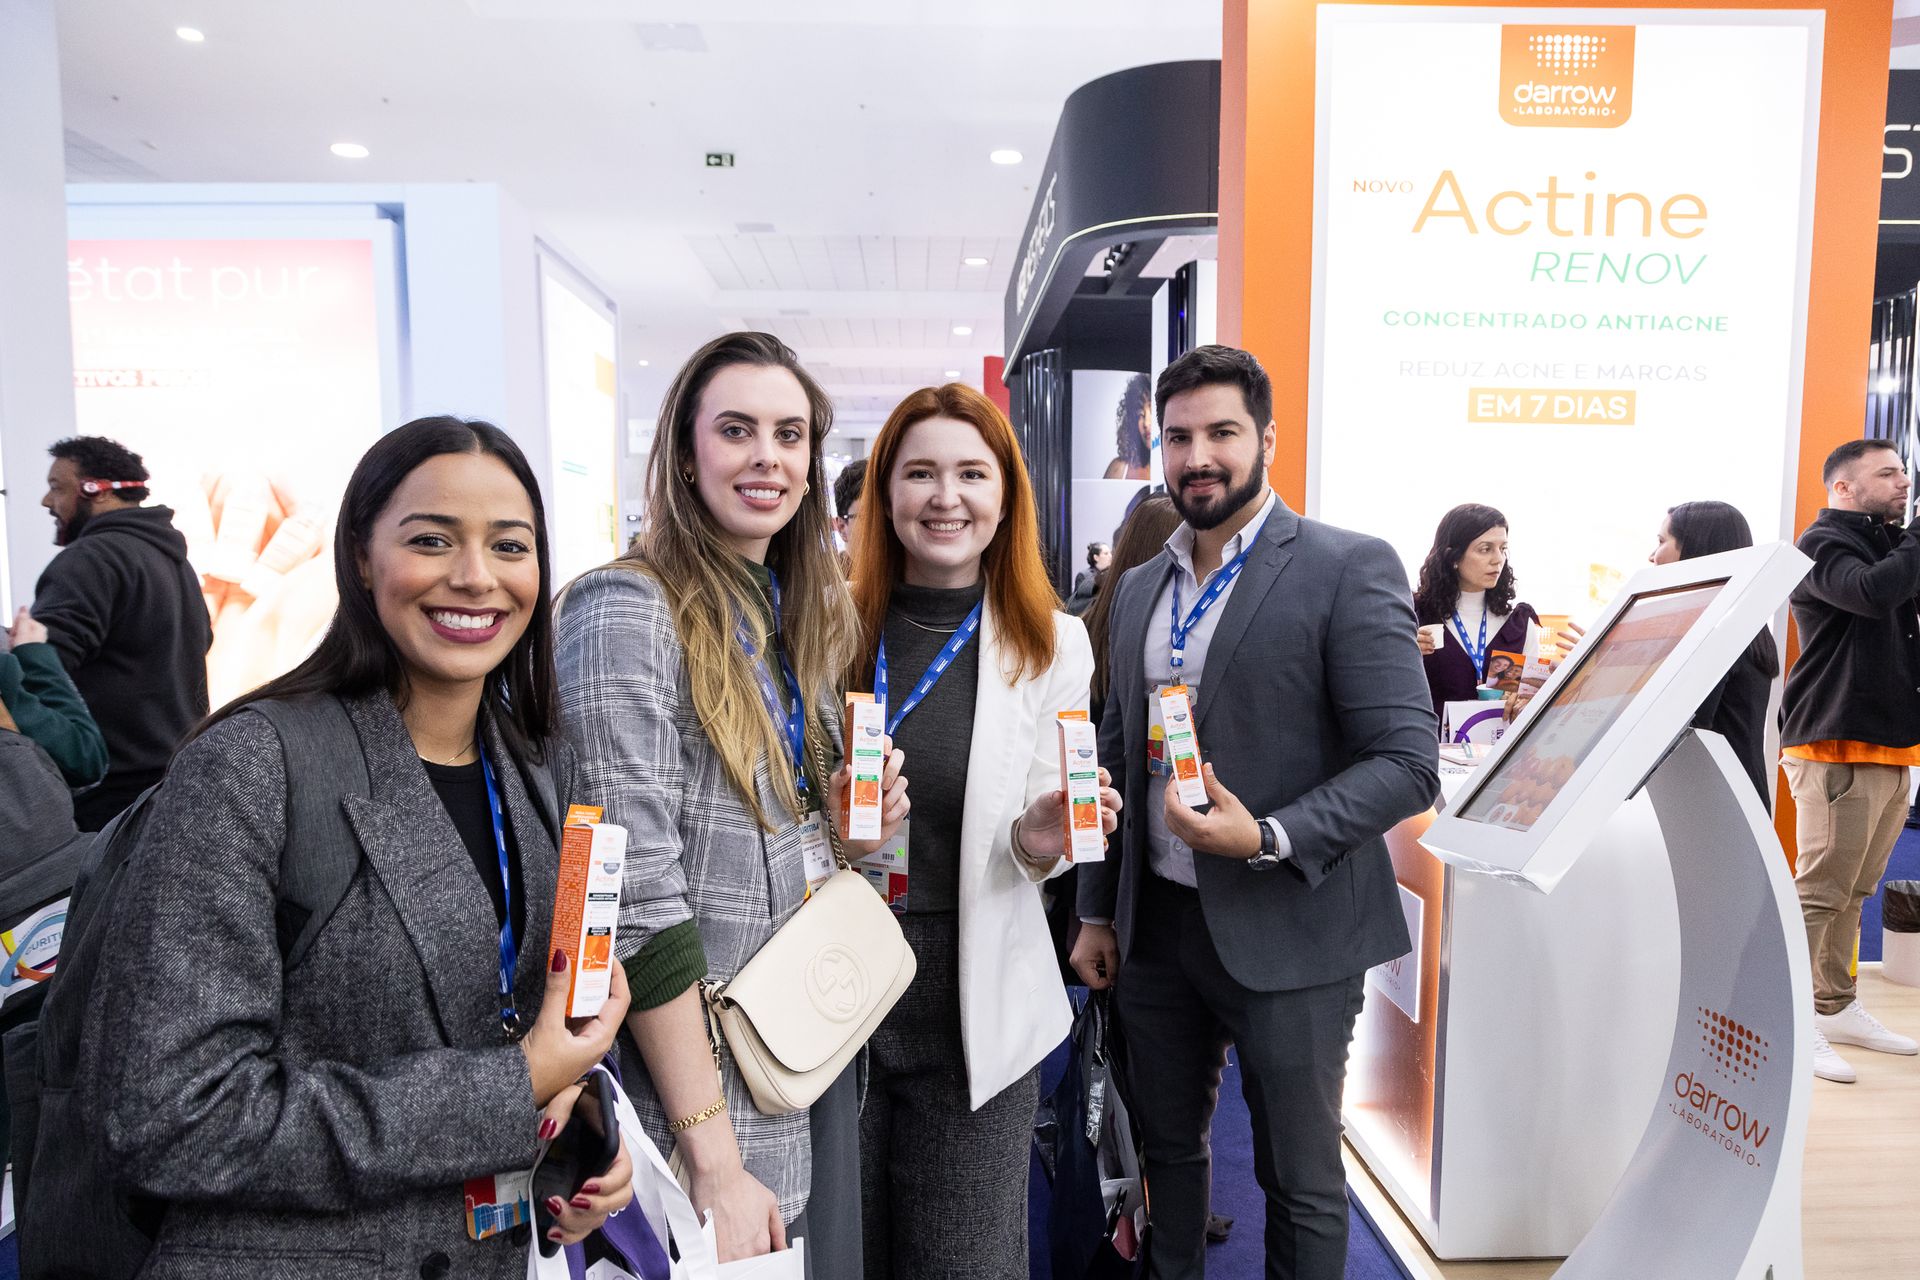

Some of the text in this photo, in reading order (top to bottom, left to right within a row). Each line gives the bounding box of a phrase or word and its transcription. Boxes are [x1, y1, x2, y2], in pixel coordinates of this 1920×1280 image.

[1513, 80, 1617, 105] darrow
[1353, 179, 1414, 194] NOVO
[1410, 169, 1709, 240] Actine
[1529, 251, 1709, 285] RENOV
[210, 264, 321, 312] pur
[1383, 309, 1730, 332] CONCENTRADO ANTIACNE
[1399, 359, 1708, 383] REDUZ ACNE E MARCAS
[1475, 394, 1628, 421] EM 7 DIAS
[1674, 1071, 1770, 1149] darrow
